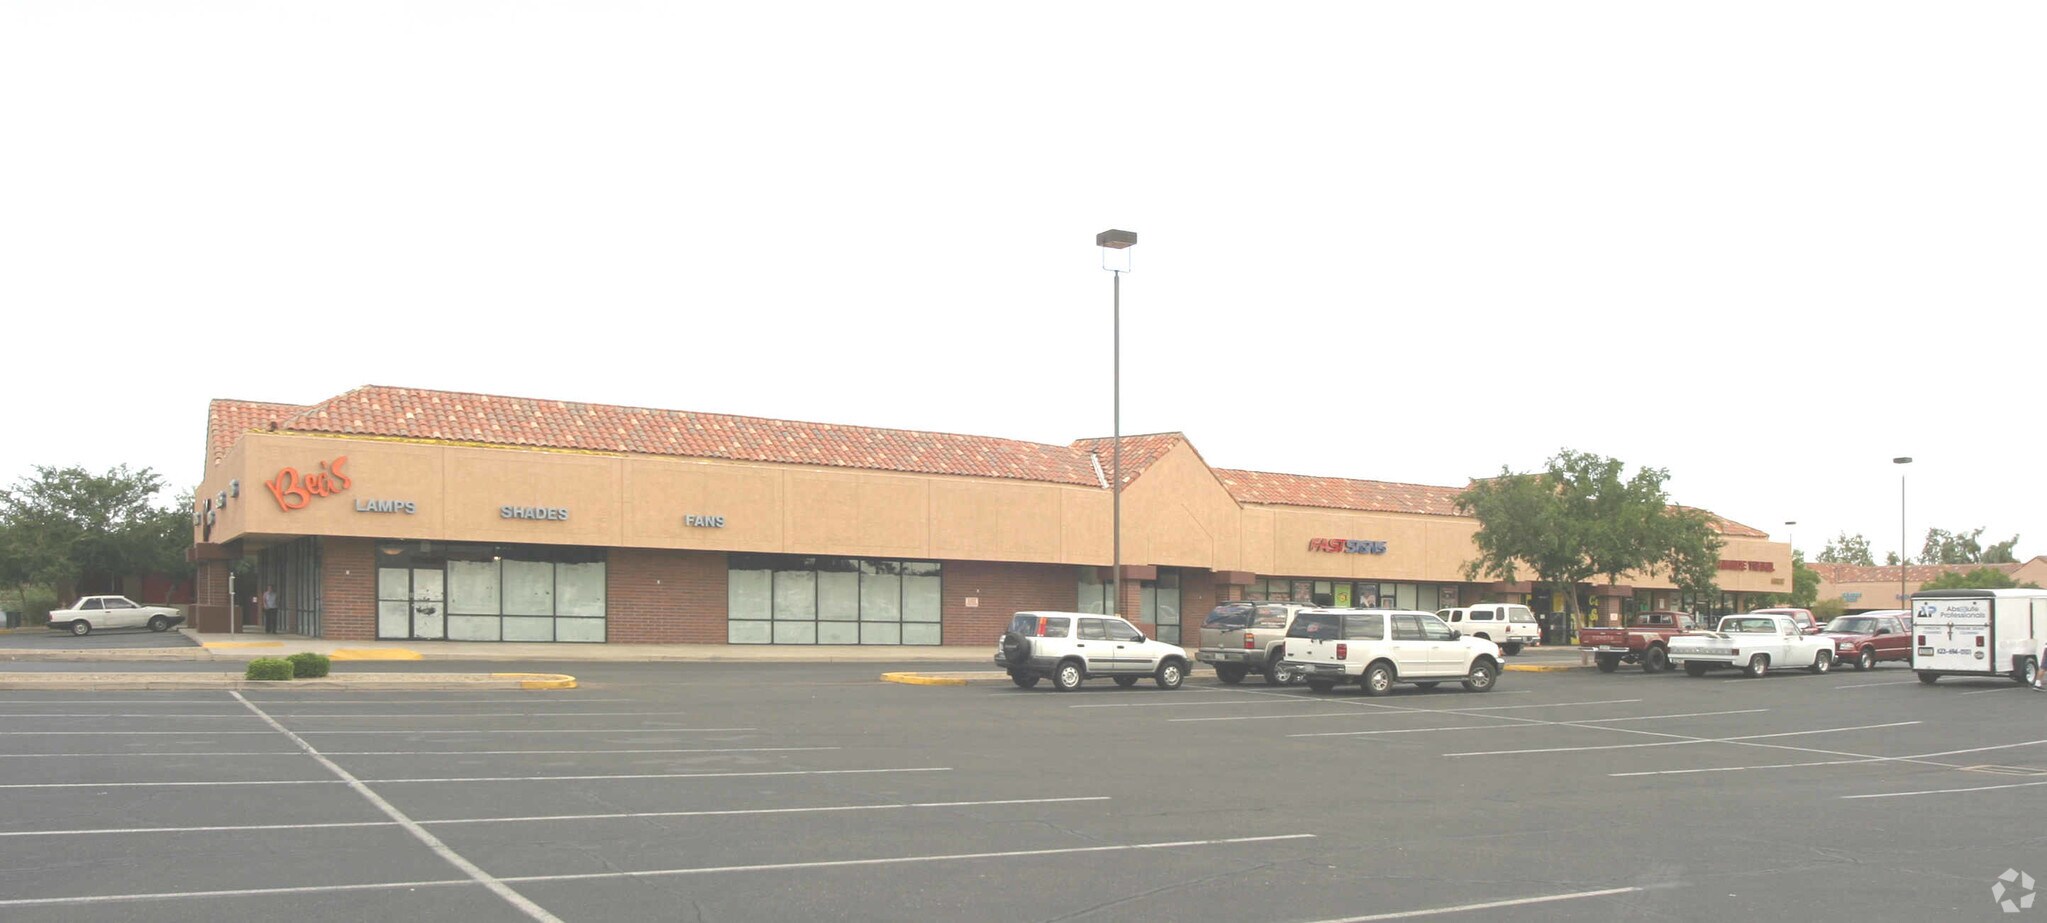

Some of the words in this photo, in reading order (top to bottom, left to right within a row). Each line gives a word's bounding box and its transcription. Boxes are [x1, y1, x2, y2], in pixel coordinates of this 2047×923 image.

[355, 498, 416, 514] LAMPS
[501, 505, 569, 521] SHADES
[684, 513, 725, 528] FANS
[1307, 538, 1388, 555] FASTSIGNS
[1917, 606, 1937, 618] AP
